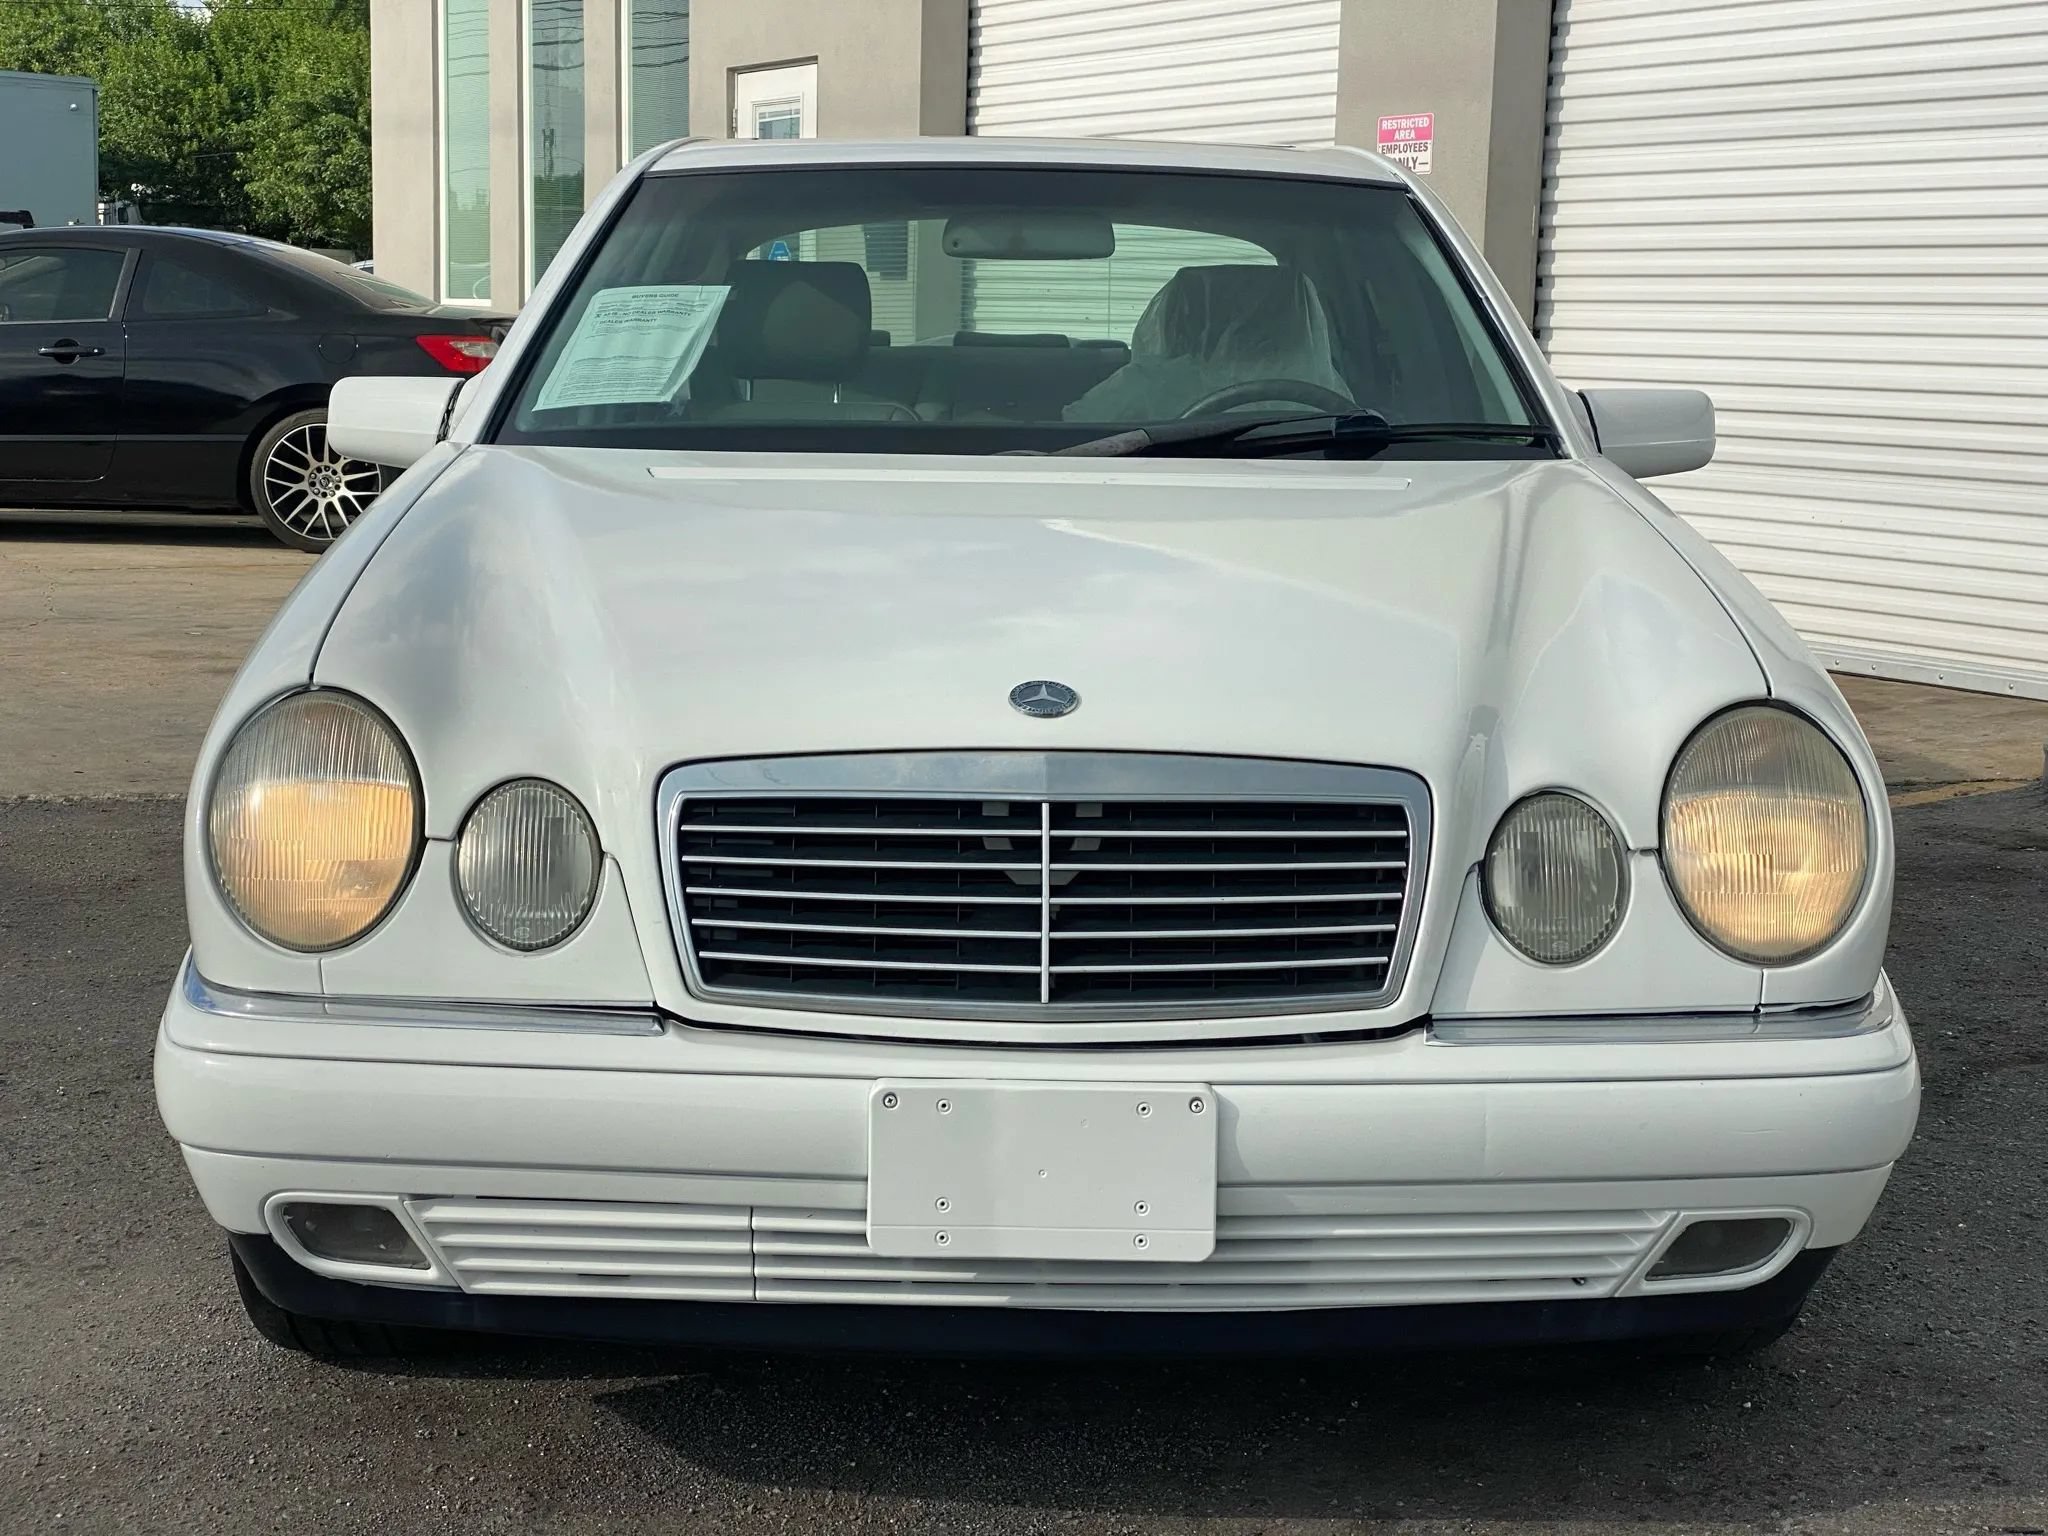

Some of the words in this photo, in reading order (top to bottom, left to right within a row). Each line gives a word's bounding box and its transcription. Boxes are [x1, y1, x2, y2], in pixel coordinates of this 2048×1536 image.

[1382, 117, 1429, 130] RESTRICTED
[1394, 129, 1416, 140] AREA
[1381, 142, 1428, 154] EMPLOYEES
[1394, 156, 1418, 170] NLY
